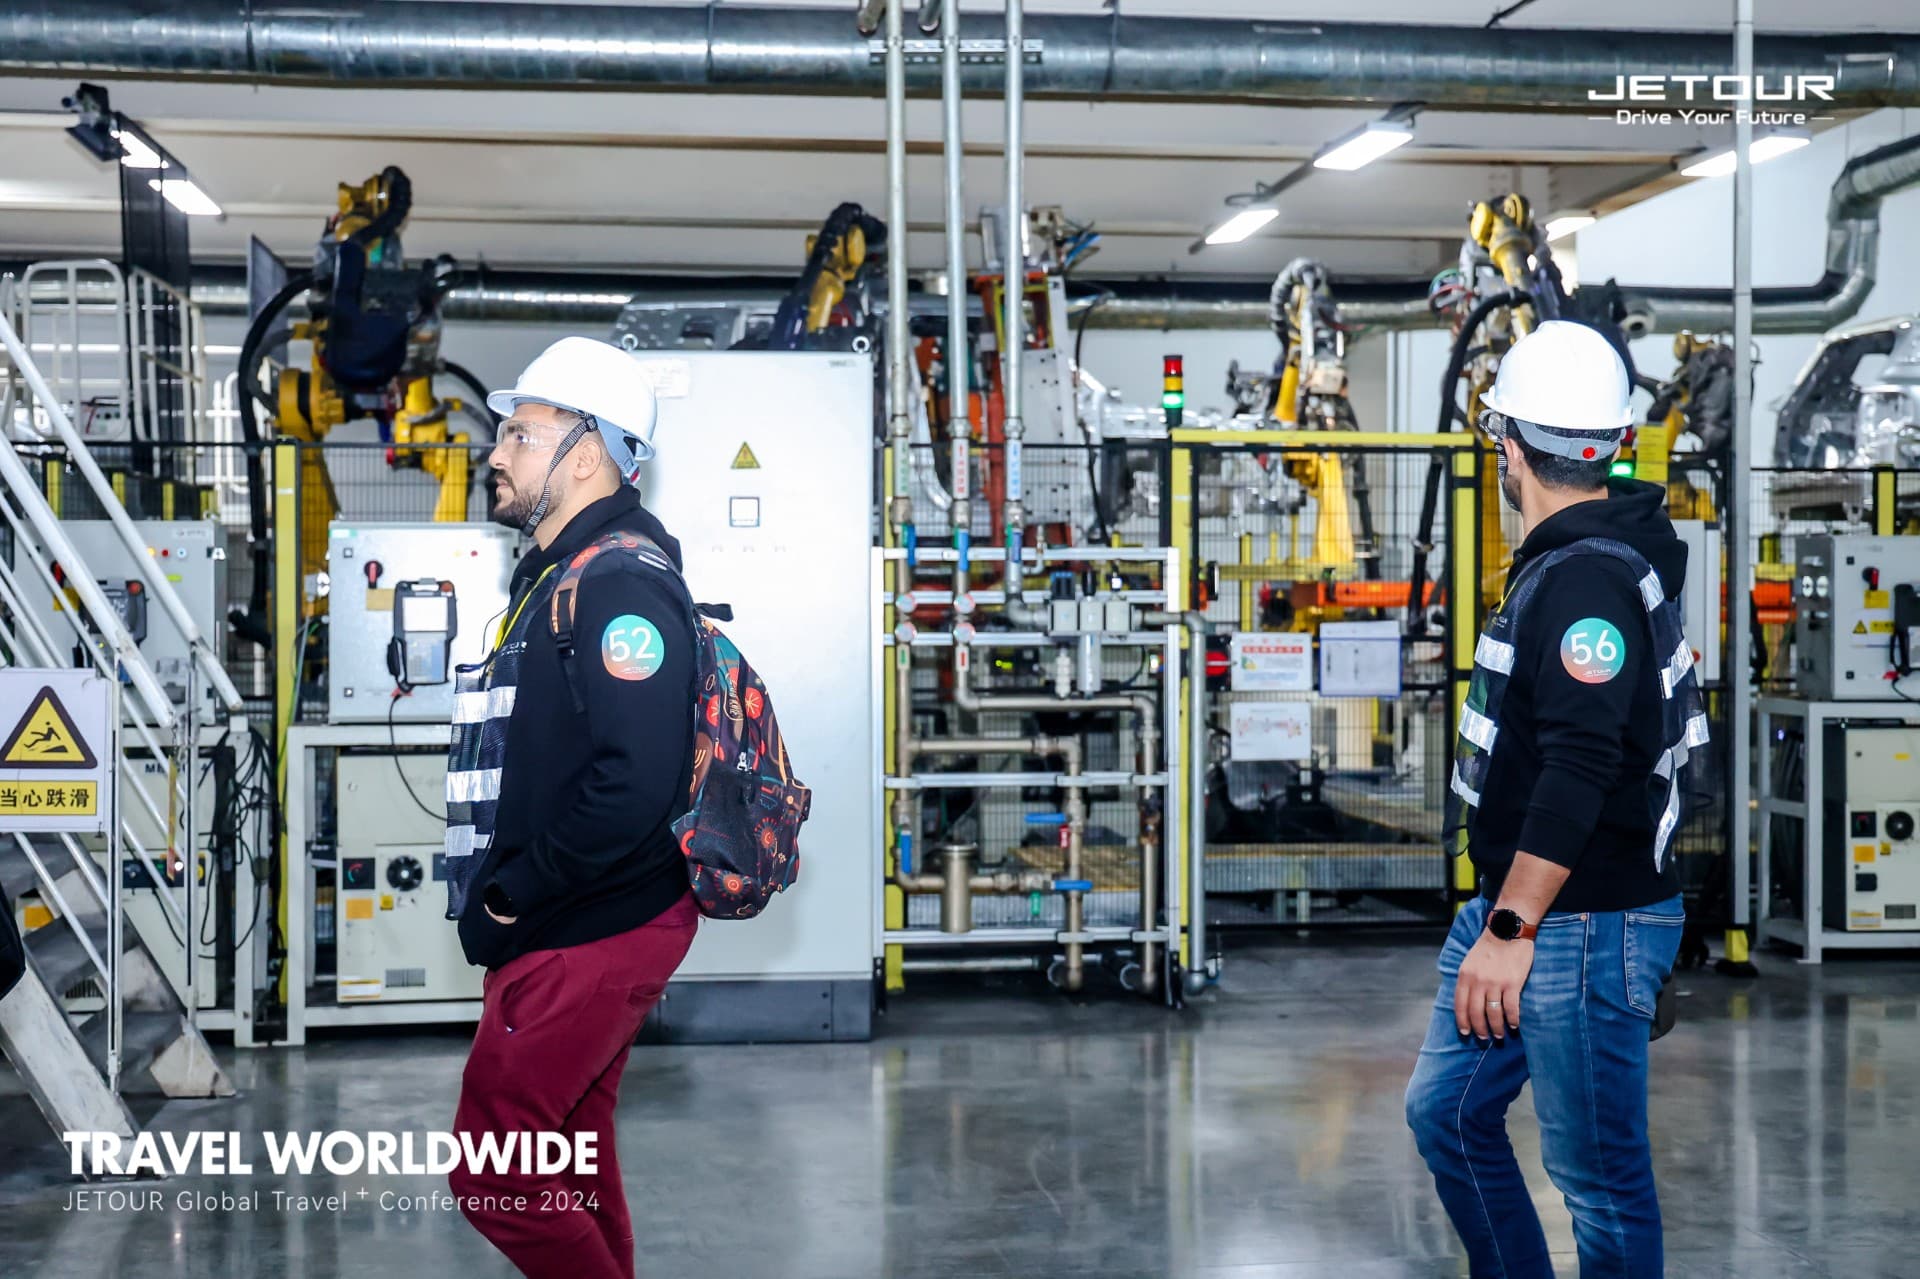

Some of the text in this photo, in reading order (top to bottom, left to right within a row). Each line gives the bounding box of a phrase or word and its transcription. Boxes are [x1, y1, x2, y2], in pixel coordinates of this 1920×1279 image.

[608, 626, 657, 662] 52
[1570, 629, 1617, 665] 56
[0, 788, 90, 808] 当心跌滑
